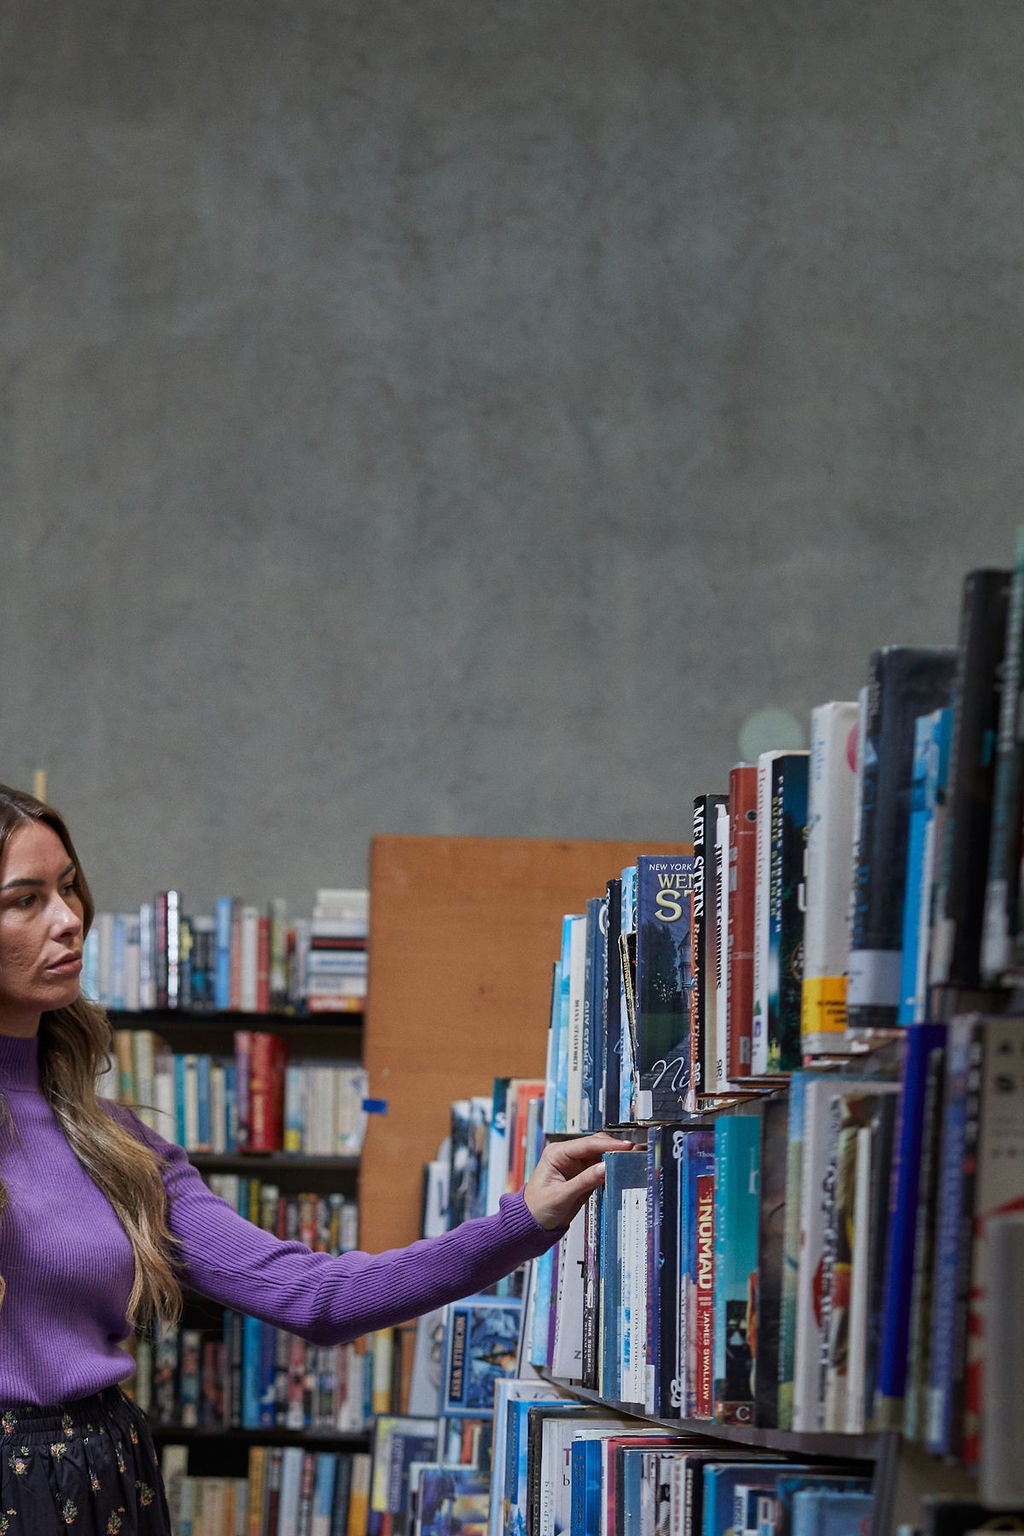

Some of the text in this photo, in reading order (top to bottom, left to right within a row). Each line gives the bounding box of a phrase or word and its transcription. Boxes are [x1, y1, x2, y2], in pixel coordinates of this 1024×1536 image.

[757, 767, 767, 885] Homecoming
[657, 874, 695, 888] WEN
[694, 855, 704, 917] STEIN
[699, 1205, 712, 1289] NOMAD
